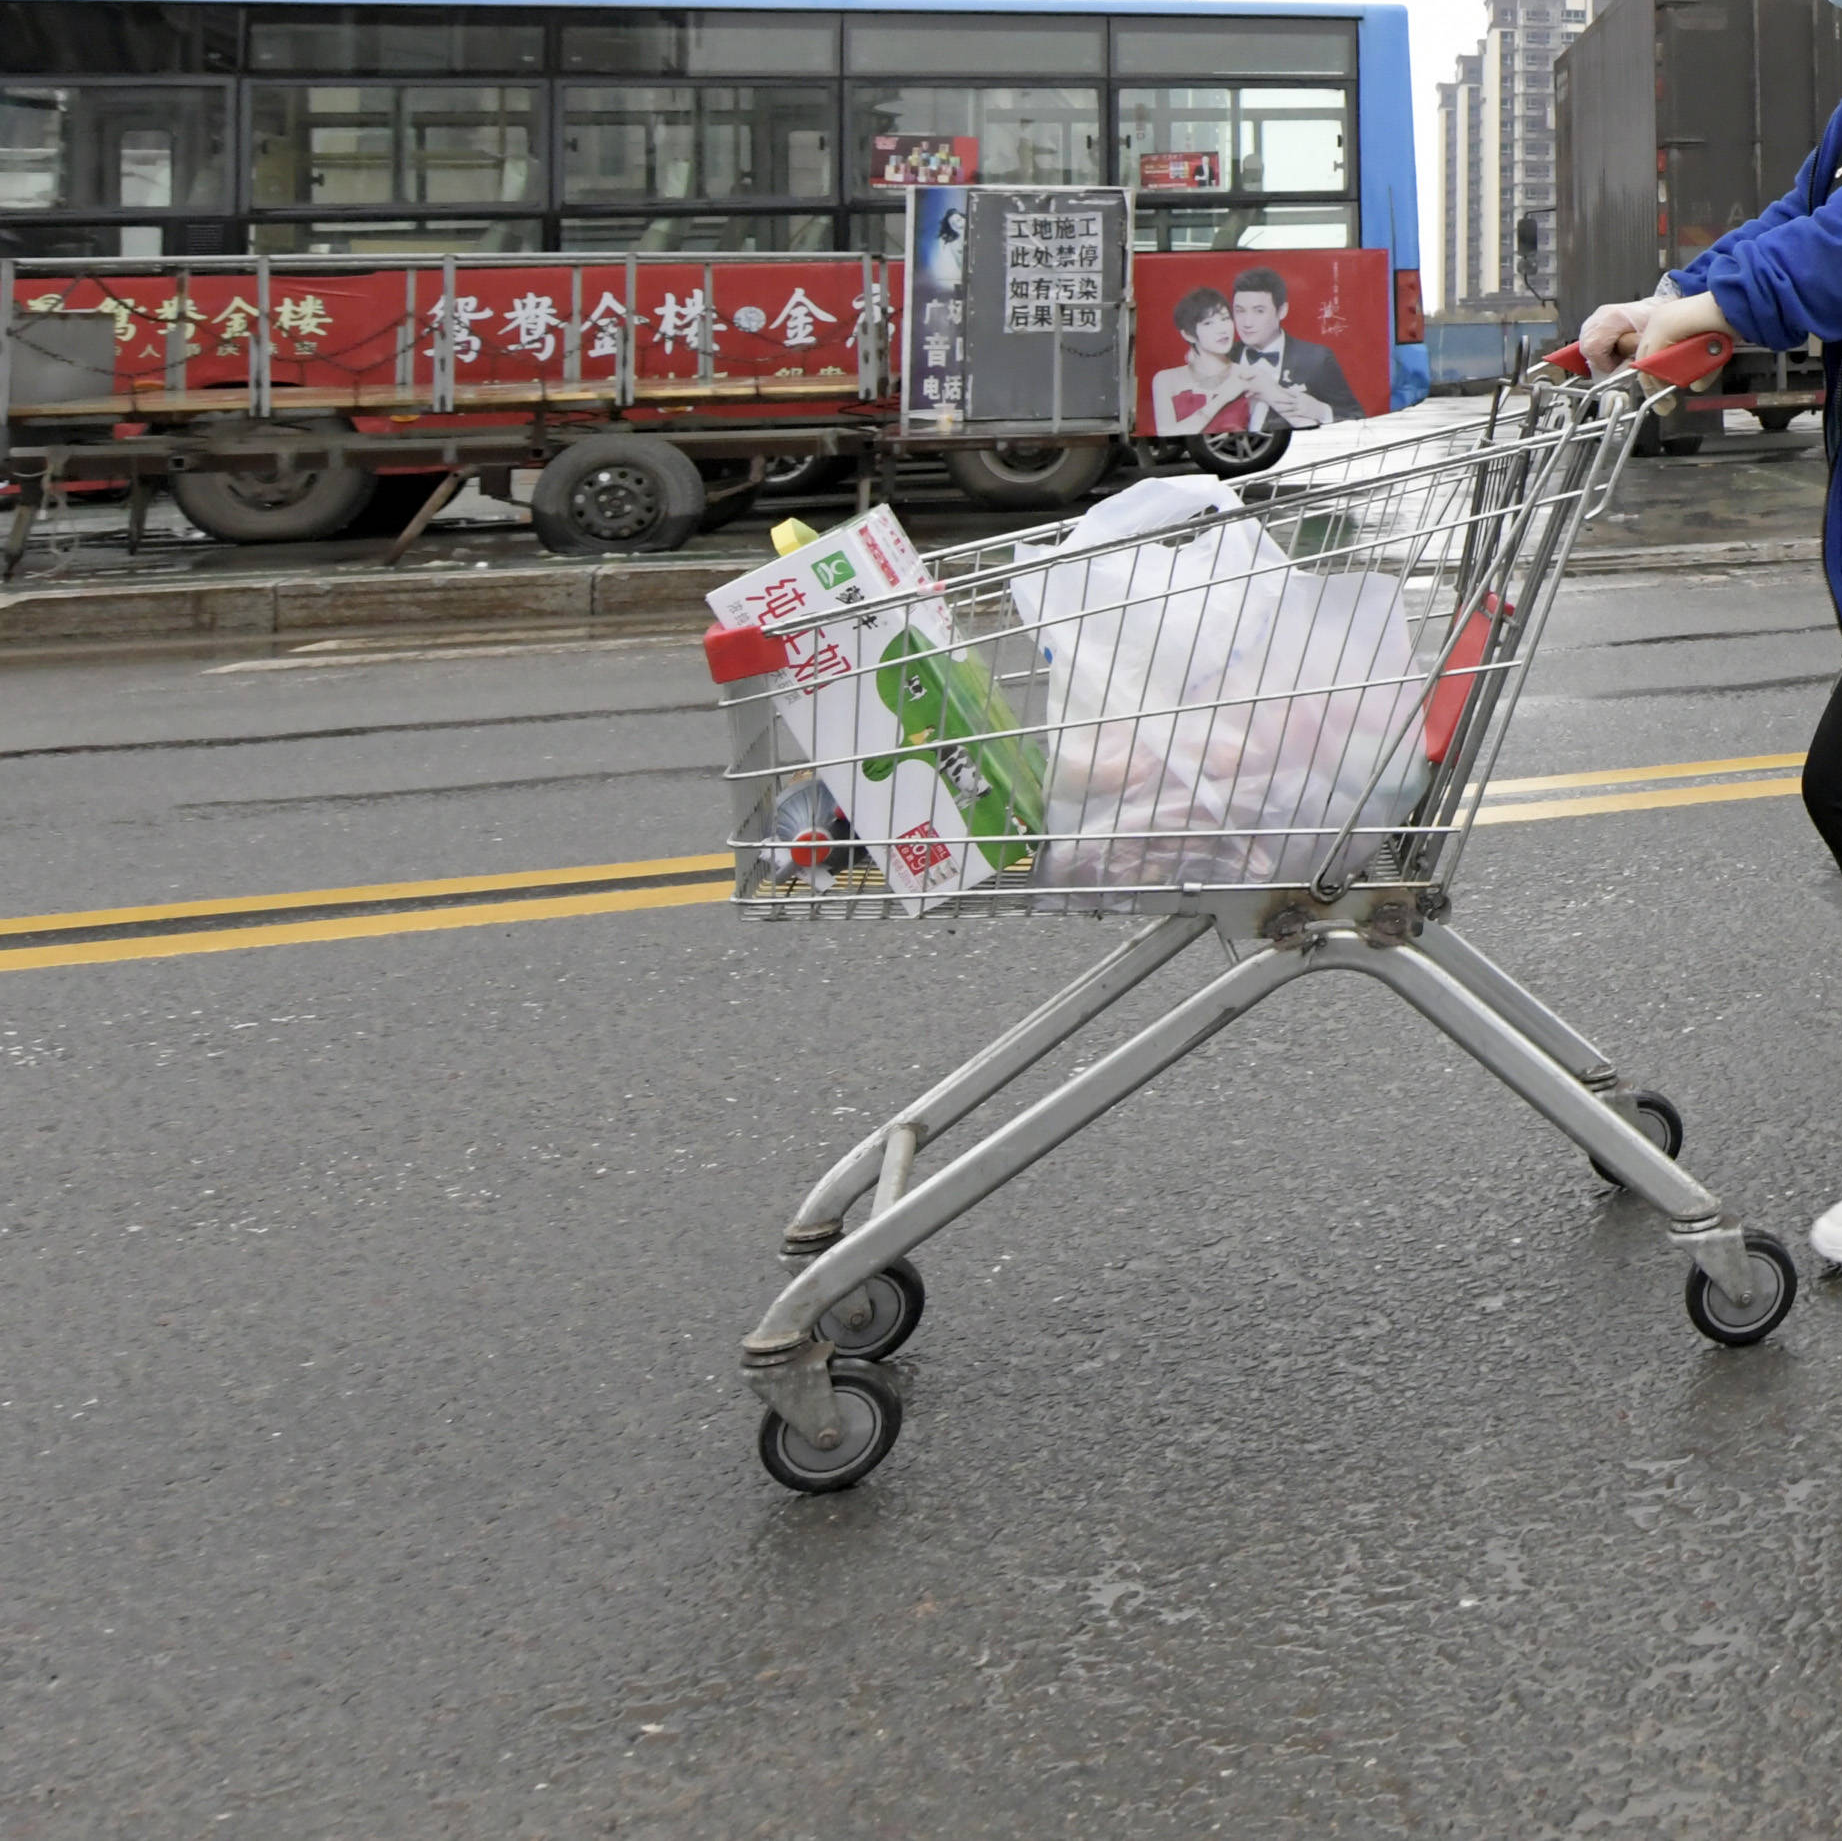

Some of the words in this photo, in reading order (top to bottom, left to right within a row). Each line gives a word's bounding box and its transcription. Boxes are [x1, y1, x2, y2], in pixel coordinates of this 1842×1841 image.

[1010, 217, 1099, 240] 工地施工
[1010, 244, 1099, 269] 此处禁停
[1009, 276, 1098, 301] 如有污染
[423, 288, 727, 363] 鸳鸯金楼
[1009, 304, 1098, 328] 后果自负
[923, 332, 964, 368] 音
[922, 375, 963, 401] 电话
[744, 578, 852, 696] 纯牛奶
